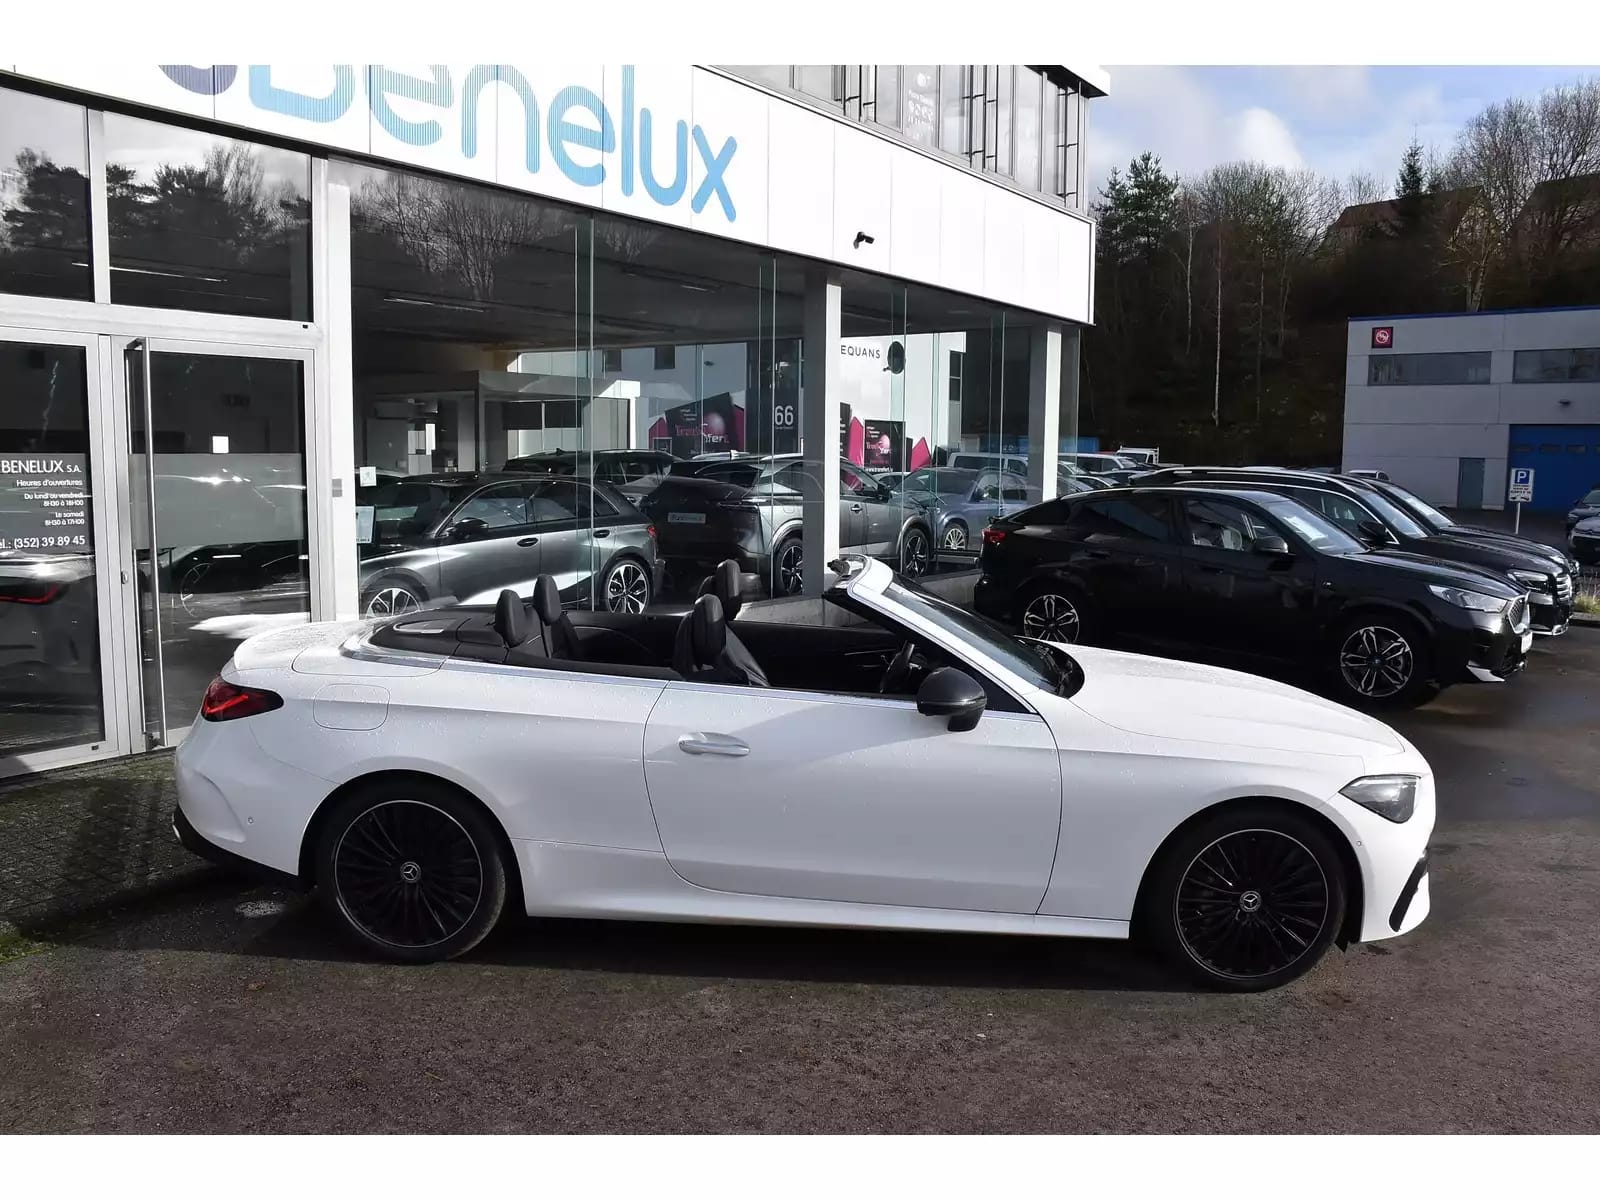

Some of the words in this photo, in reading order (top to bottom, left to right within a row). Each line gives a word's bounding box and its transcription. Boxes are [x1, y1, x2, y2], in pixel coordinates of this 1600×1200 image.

[840, 344, 880, 359] EQUANS
[774, 405, 794, 426] 66
[1, 459, 64, 474] BENELUX
[16, 479, 42, 487] Heures
[43, 478, 83, 486] d'ouvertures
[1517, 471, 1527, 483] P
[14, 537, 39, 550] (352)
[41, 537, 55, 548] 39
[56, 536, 71, 546] 89
[72, 535, 86, 545] 45
